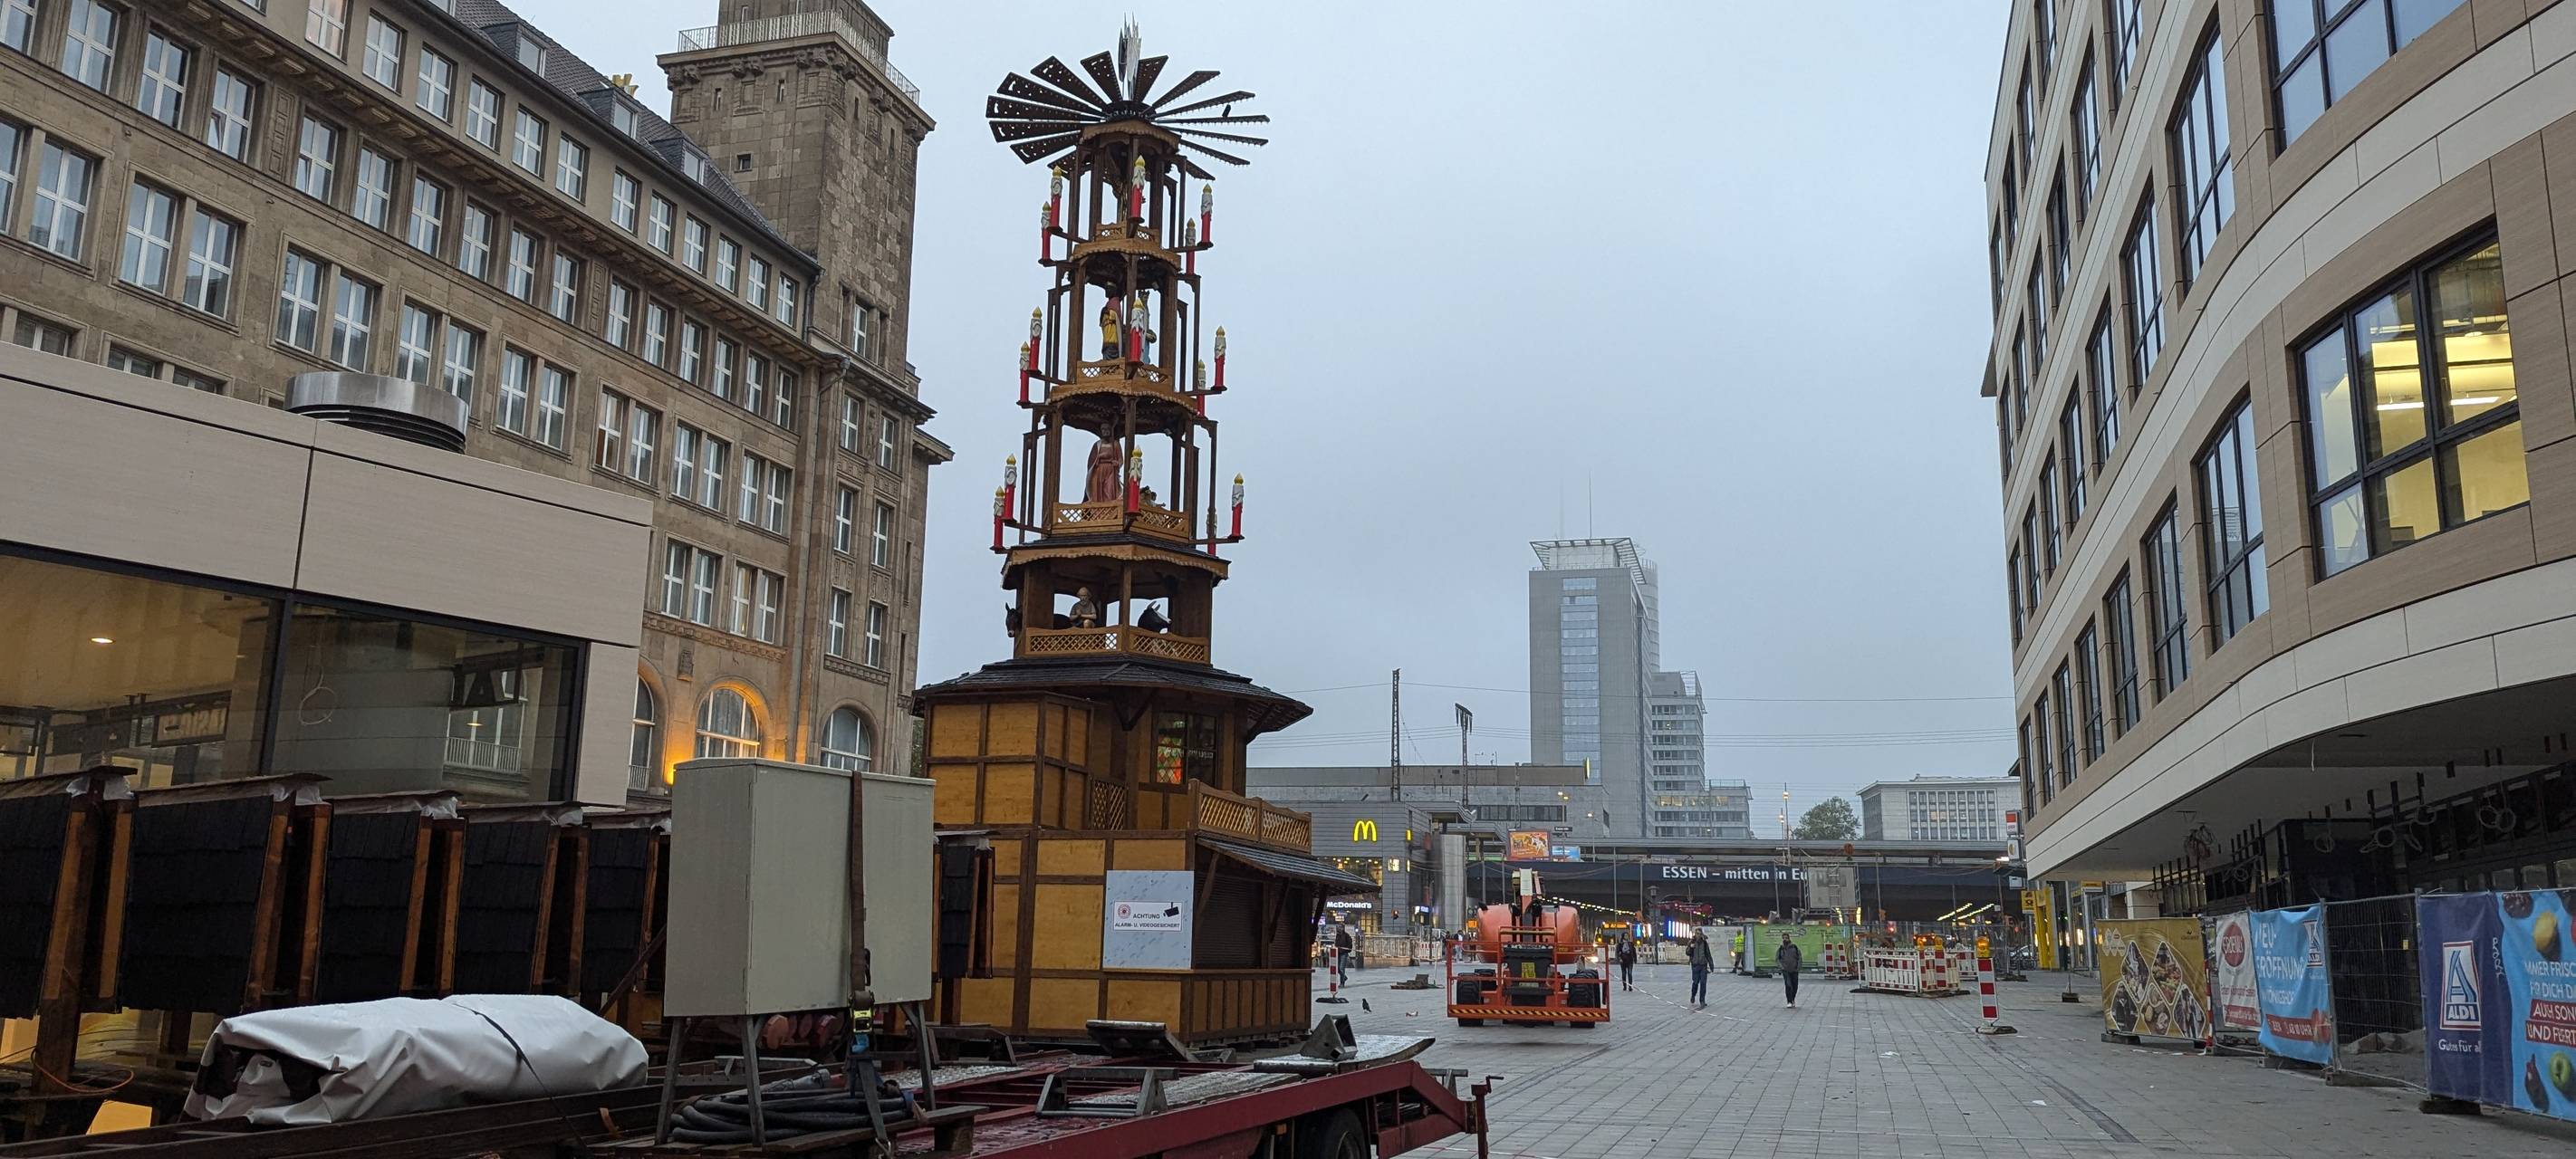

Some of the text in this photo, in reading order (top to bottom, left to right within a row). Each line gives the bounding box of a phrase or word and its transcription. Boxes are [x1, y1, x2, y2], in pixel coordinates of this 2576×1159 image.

[1662, 866, 1707, 879] ESSEN
[1725, 867, 1770, 880] mitten
[1774, 867, 1787, 880] in
[1792, 867, 1808, 881] Eu
[1326, 901, 1372, 909] McDonald's
[2542, 982, 2563, 999] DICH
[2447, 1005, 2476, 1020] ALDI
[2526, 1023, 2552, 1041] UND
[2458, 1039, 2472, 1053] für
